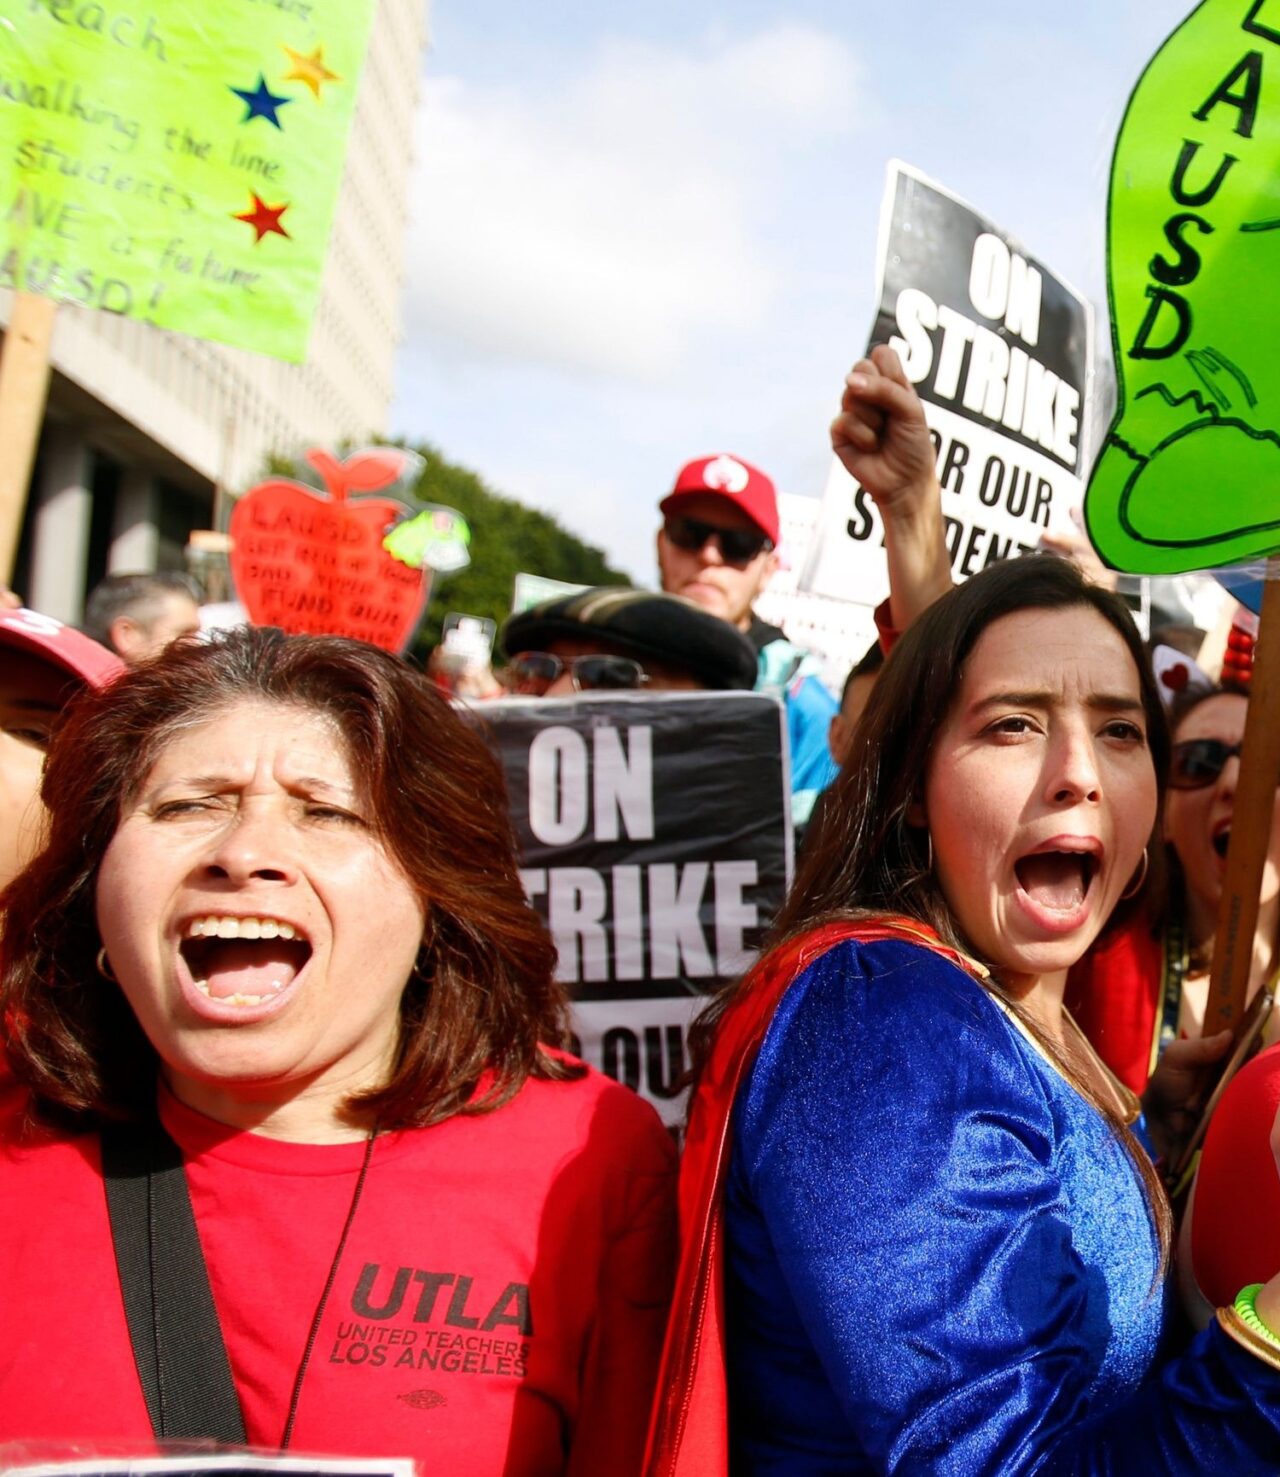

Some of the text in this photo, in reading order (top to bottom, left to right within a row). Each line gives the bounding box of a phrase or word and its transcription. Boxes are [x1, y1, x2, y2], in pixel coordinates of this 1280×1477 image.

[27, 0, 168, 61] each
[164, 125, 213, 160] the
[230, 140, 281, 182] line
[8, 188, 86, 242] AVE
[0, 248, 166, 317] AUSD!
[968, 232, 1043, 346] ON
[888, 287, 1080, 466] STRIKE
[978, 455, 1053, 528] OUR
[528, 725, 656, 846] ON
[351, 1262, 534, 1337] UTLA
[329, 1338, 528, 1378] LOS ANGELES
[336, 1321, 530, 1359] UNITED TEACHERS
